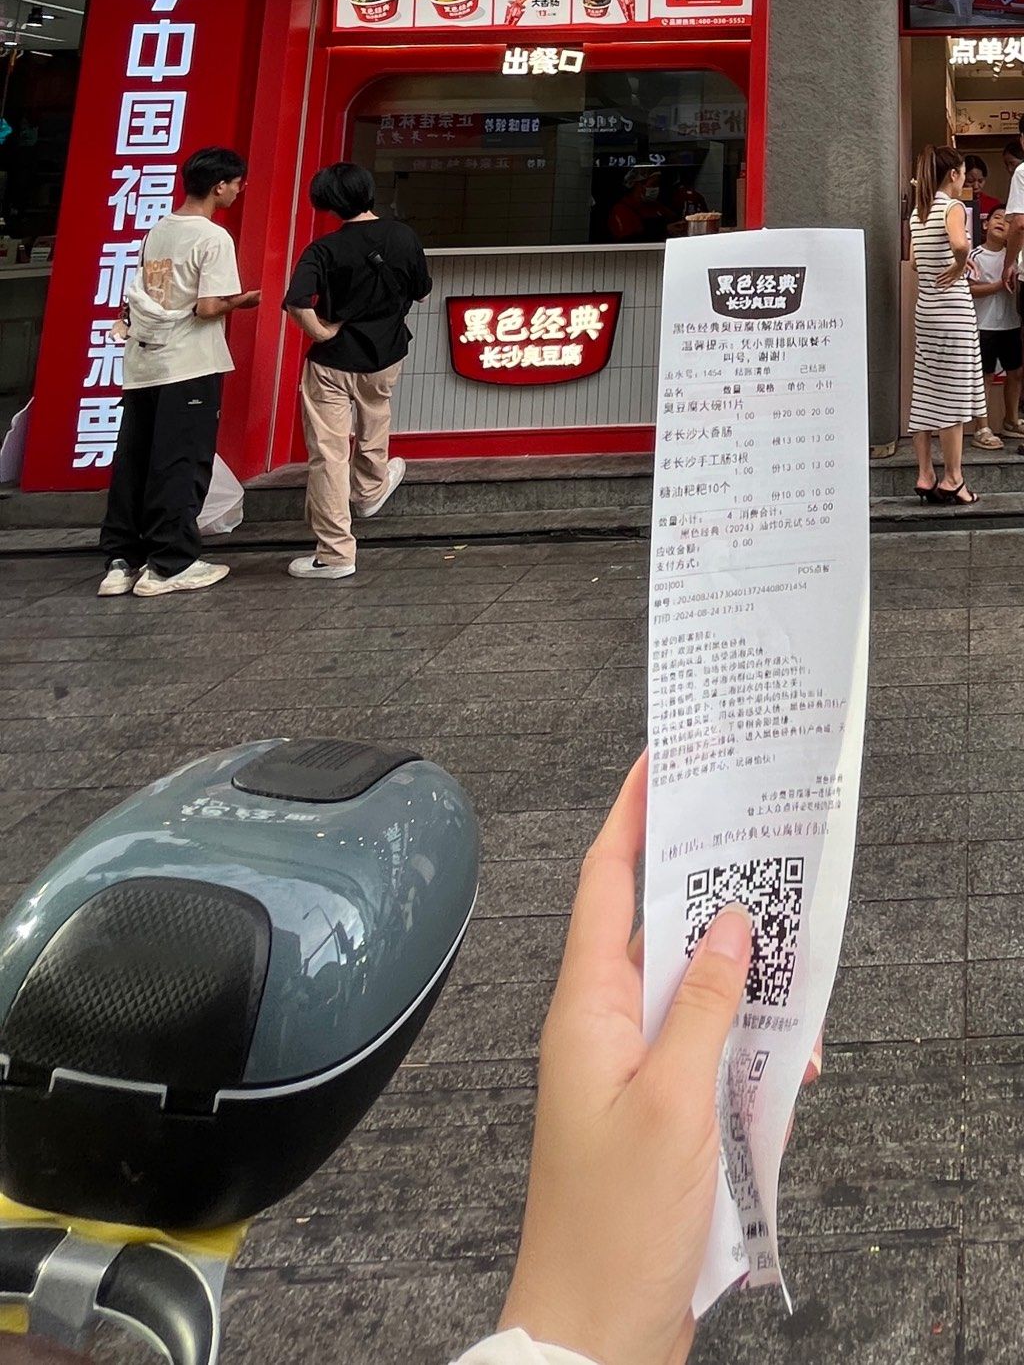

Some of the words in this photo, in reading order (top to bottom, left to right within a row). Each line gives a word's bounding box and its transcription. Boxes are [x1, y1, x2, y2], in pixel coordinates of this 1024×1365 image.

[501, 47, 586, 76] 出餐口
[715, 274, 798, 296] 黑色经典
[726, 296, 787, 310] 长沙臭豆腐
[459, 304, 605, 345] 黑色经典
[479, 344, 584, 370] 长沙臭豆腐
[727, 511, 733, 520] 4
